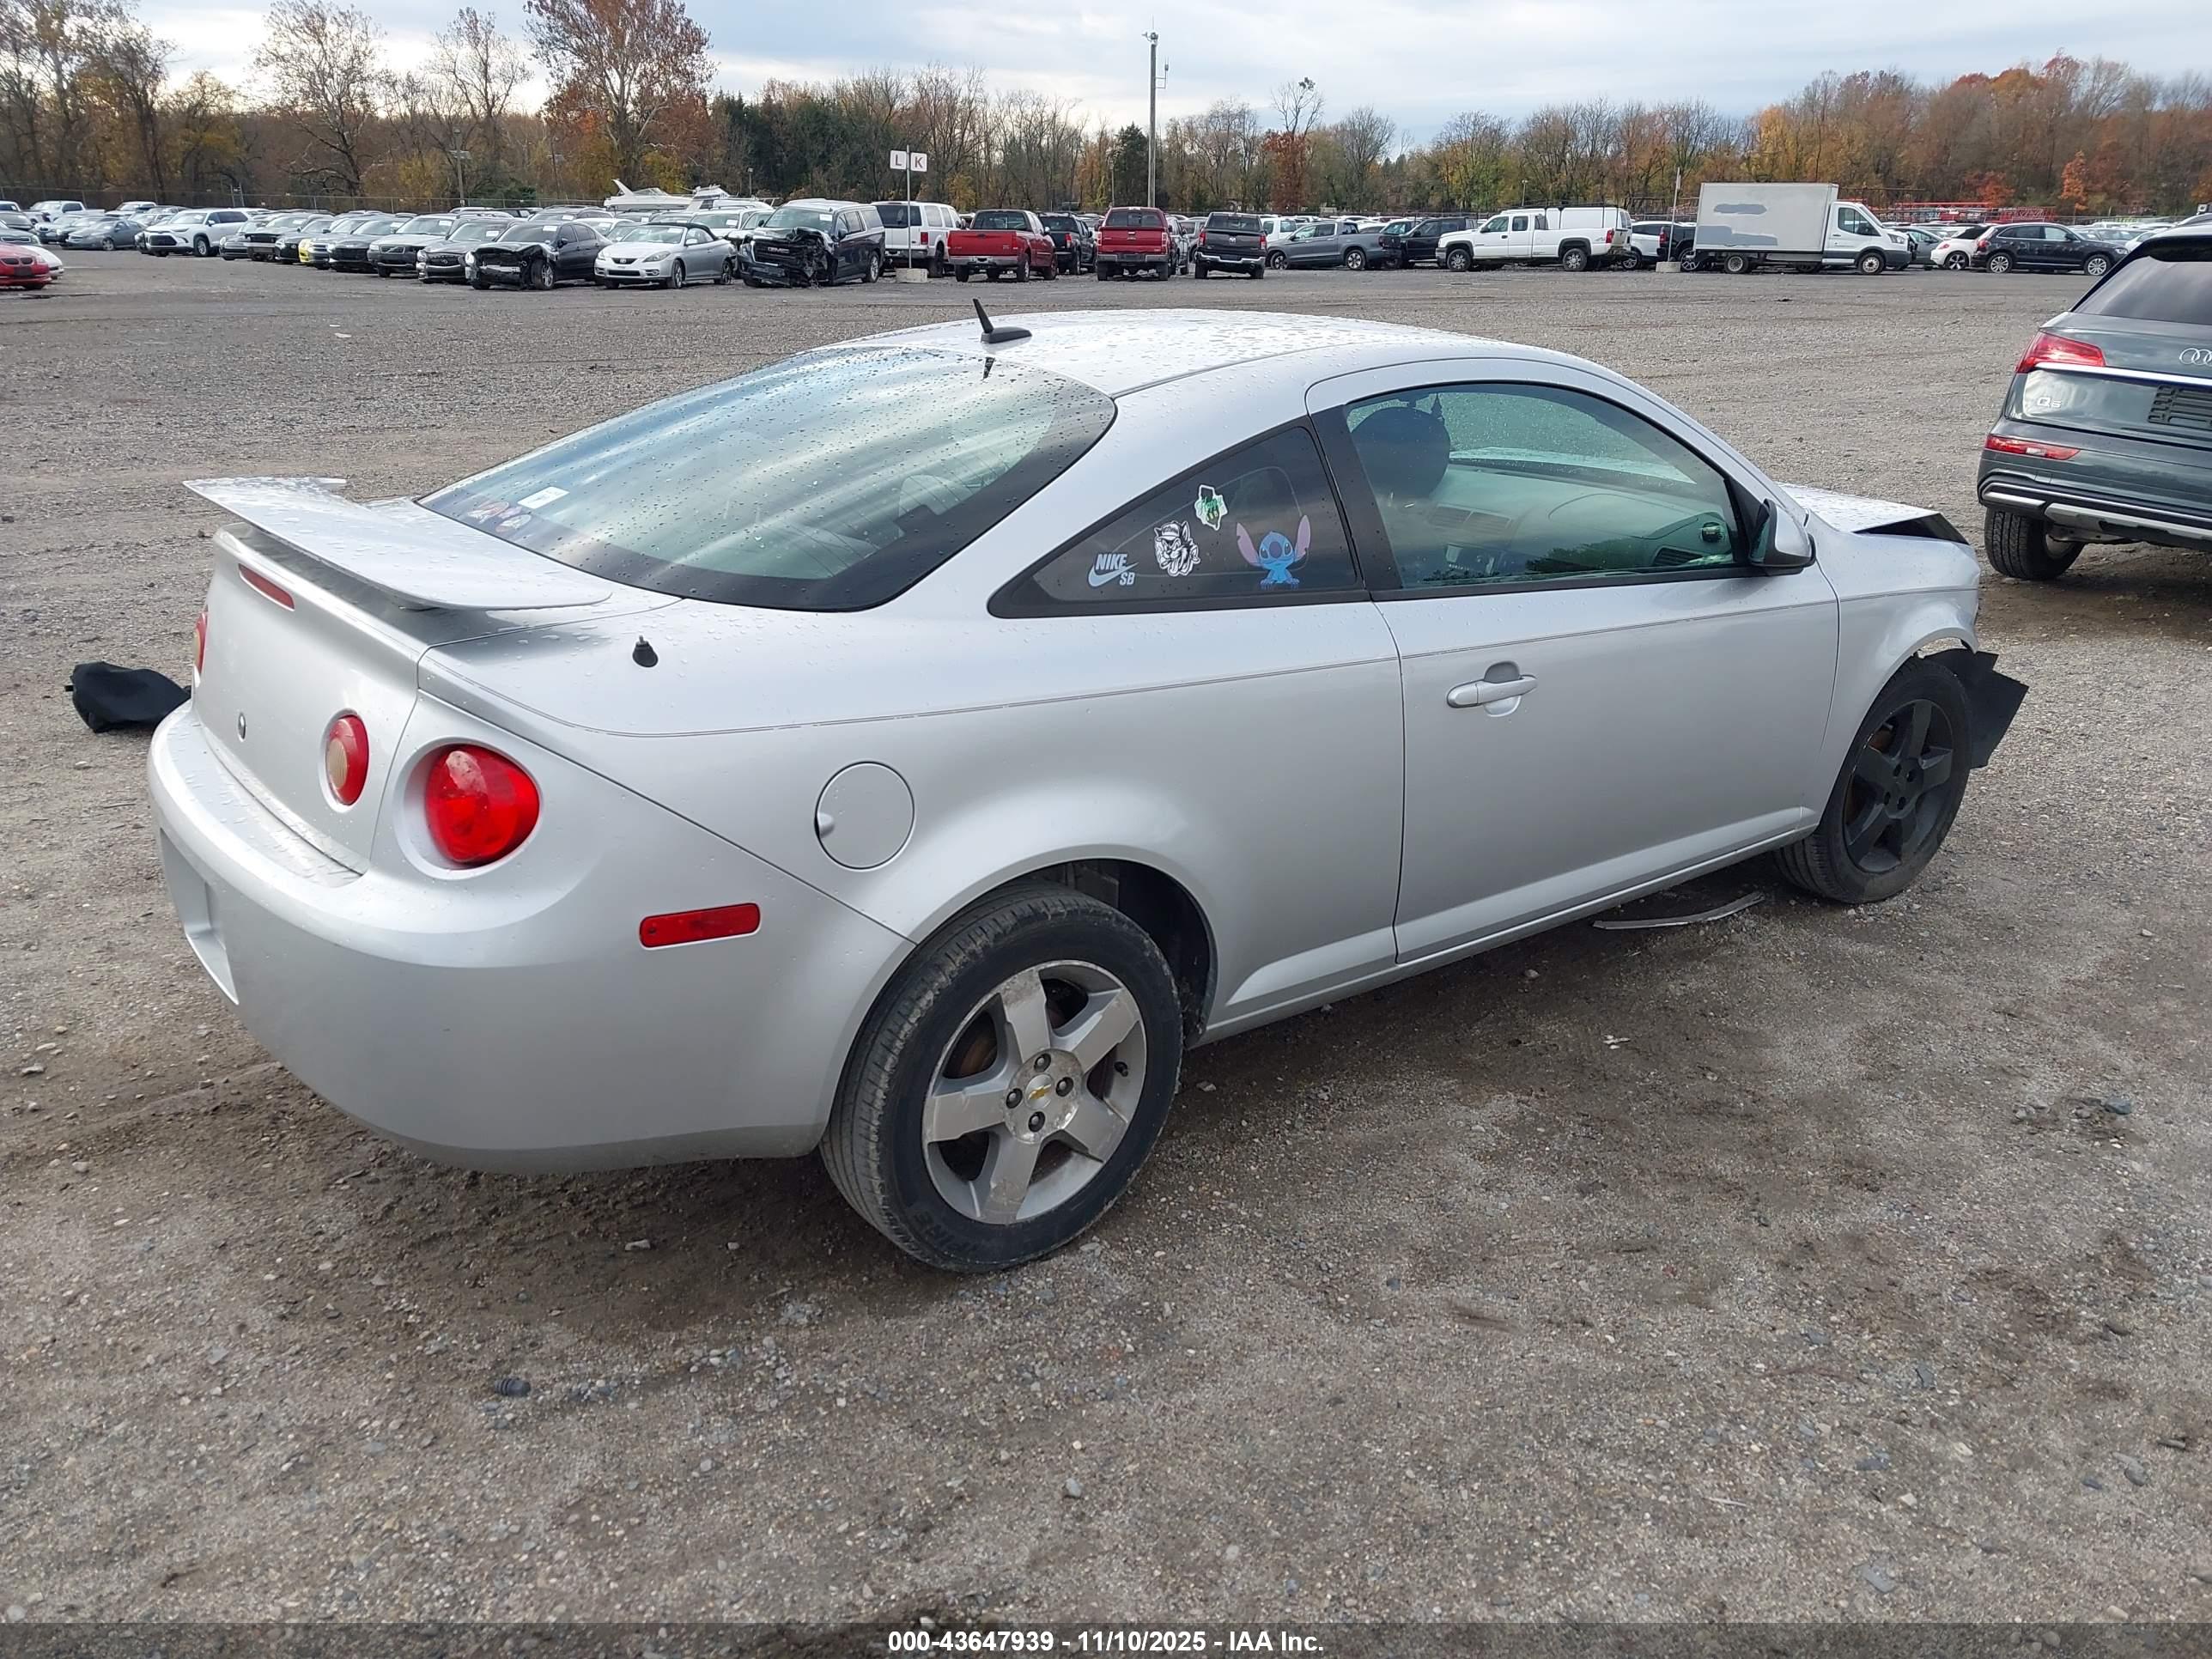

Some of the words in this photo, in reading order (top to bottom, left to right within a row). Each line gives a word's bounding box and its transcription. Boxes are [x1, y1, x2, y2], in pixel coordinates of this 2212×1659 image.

[895, 154, 902, 167] L
[915, 155, 924, 168] K
[2037, 397, 2062, 408] Q5
[1095, 553, 1128, 571] NIKE
[1119, 571, 1136, 586] SB
